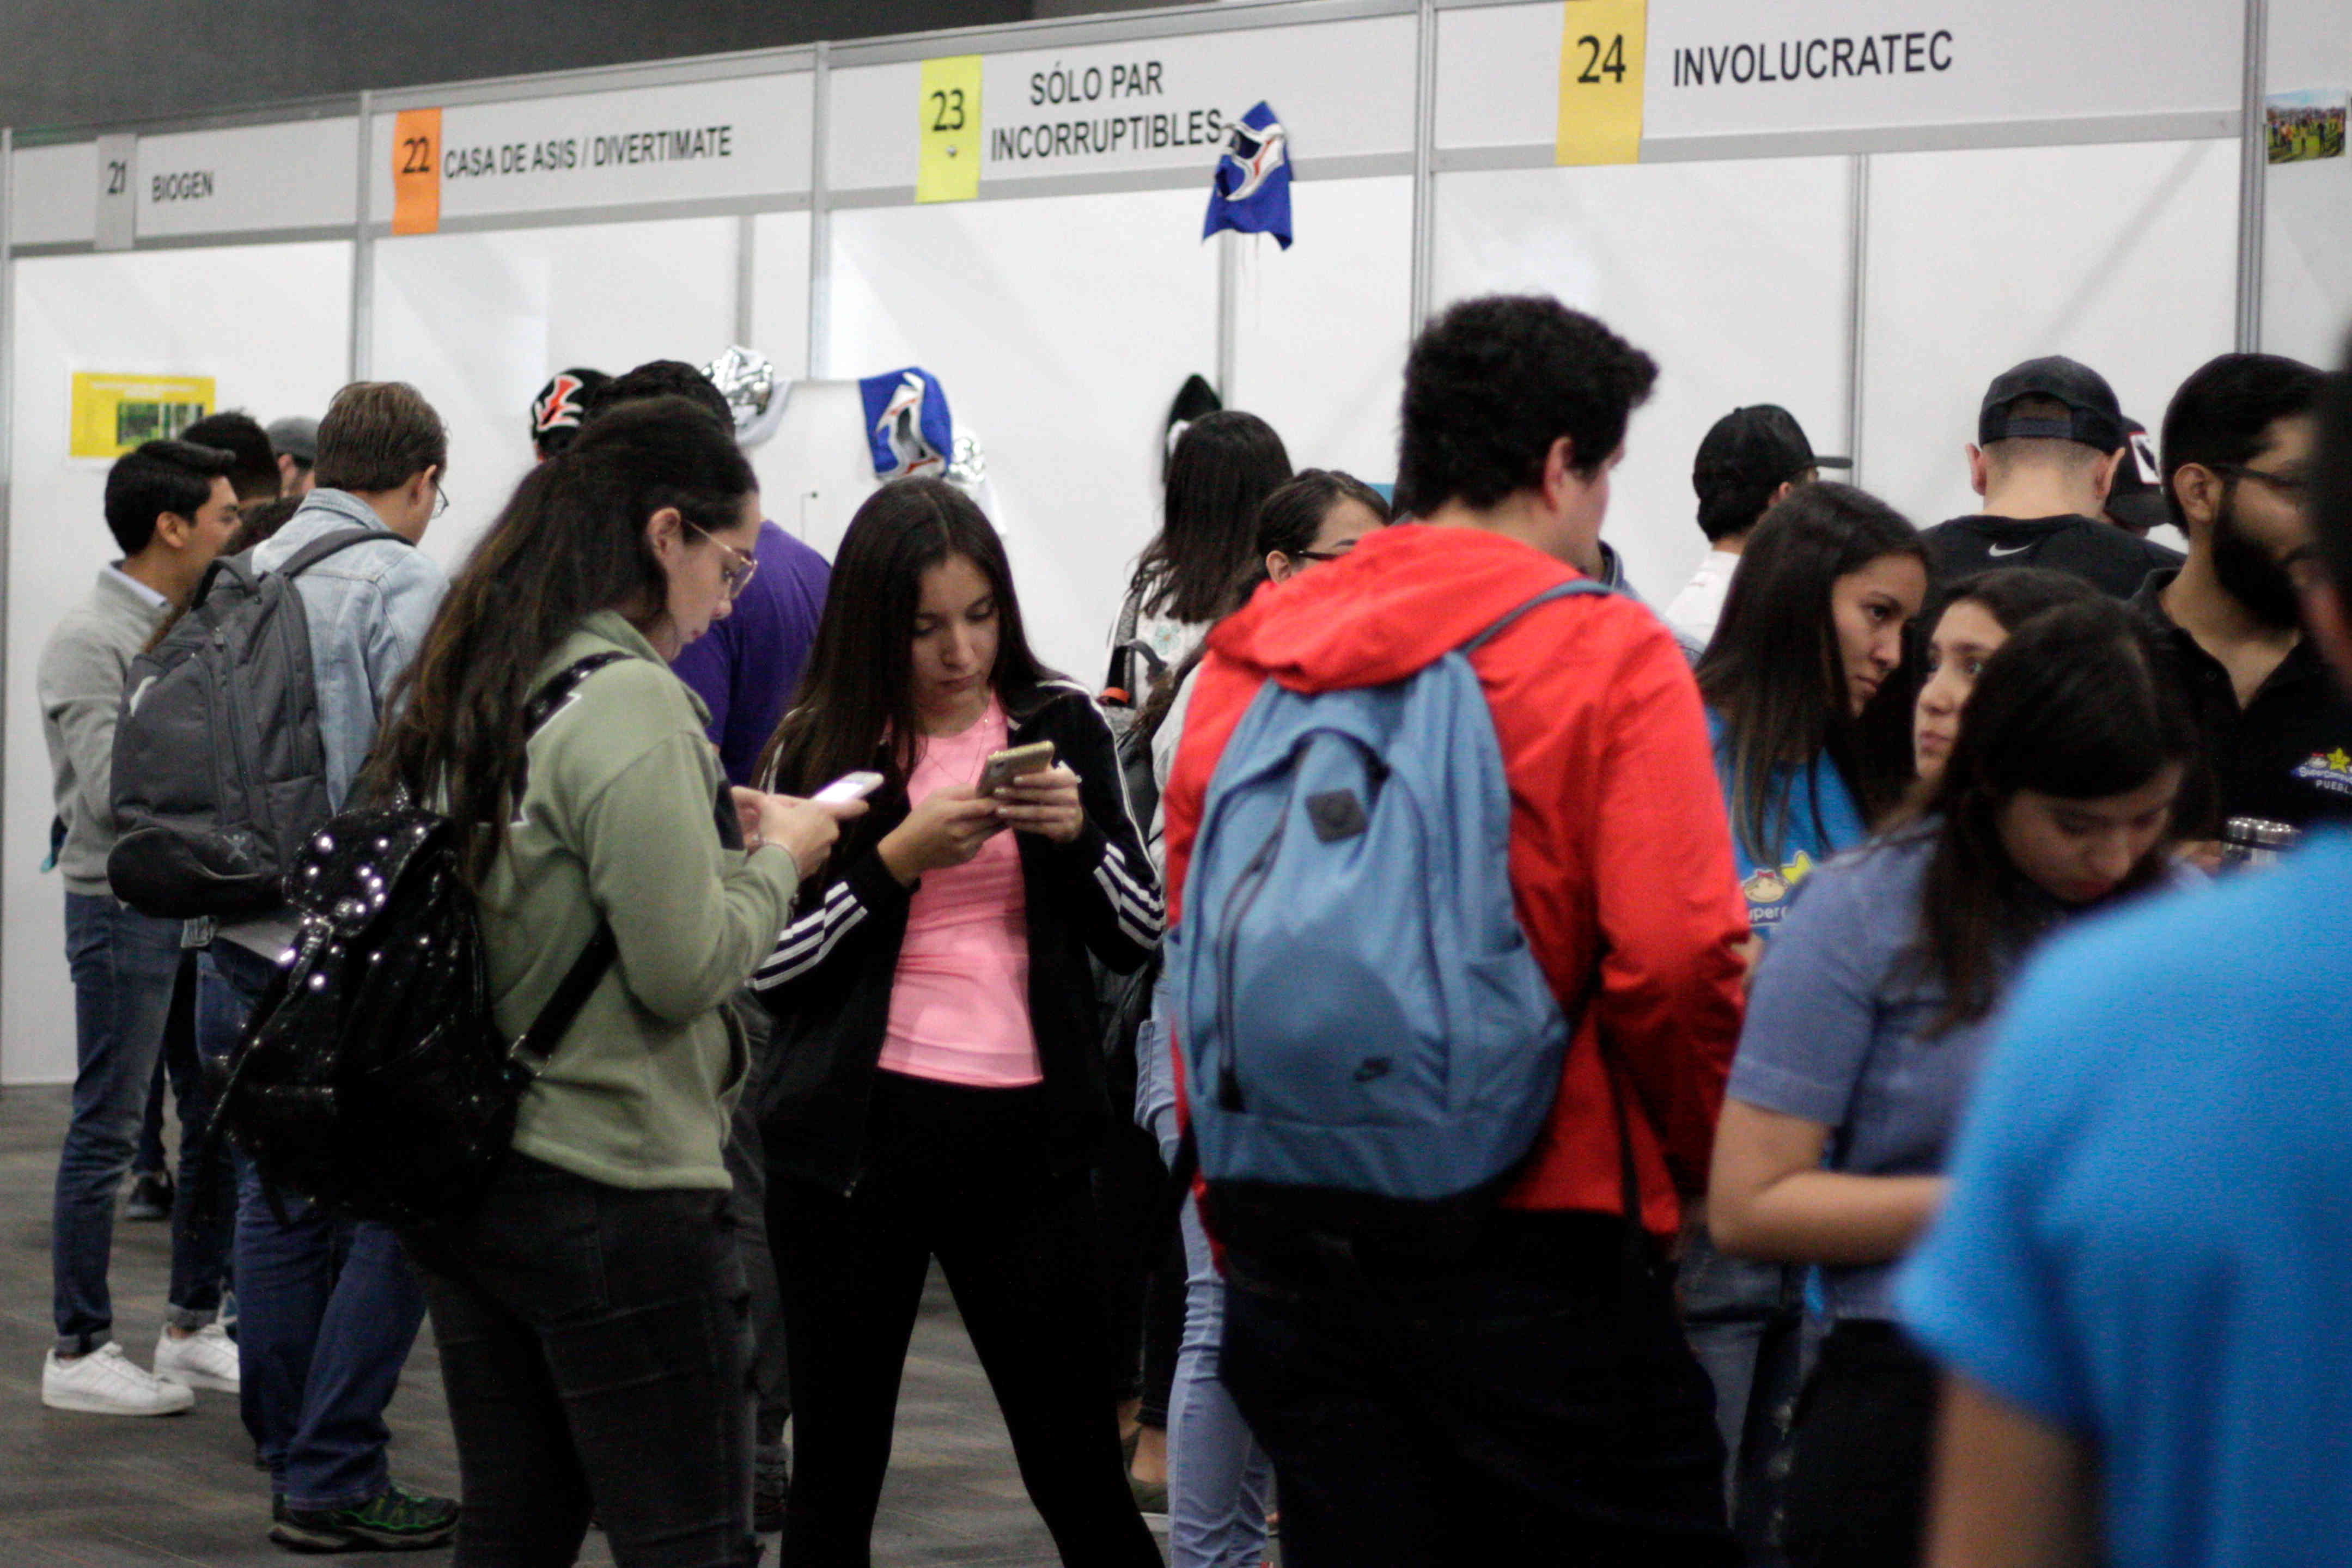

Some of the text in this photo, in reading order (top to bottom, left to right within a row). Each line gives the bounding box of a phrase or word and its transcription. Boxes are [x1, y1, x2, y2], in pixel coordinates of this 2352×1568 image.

[1576, 33, 1627, 84] 24
[1673, 29, 1953, 87] INVOLUCRATEC
[1030, 61, 1163, 106] SÓLO PAR
[931, 88, 965, 132] 23
[401, 136, 431, 175] 22
[443, 147, 495, 179] CASA
[501, 143, 526, 174] DE
[531, 137, 576, 171] ASIS
[594, 125, 733, 167] DIVERTIMATE
[991, 108, 1223, 162] INCORRUPTIBLES
[107, 160, 127, 196] 21
[151, 170, 214, 203] BIOGEN
